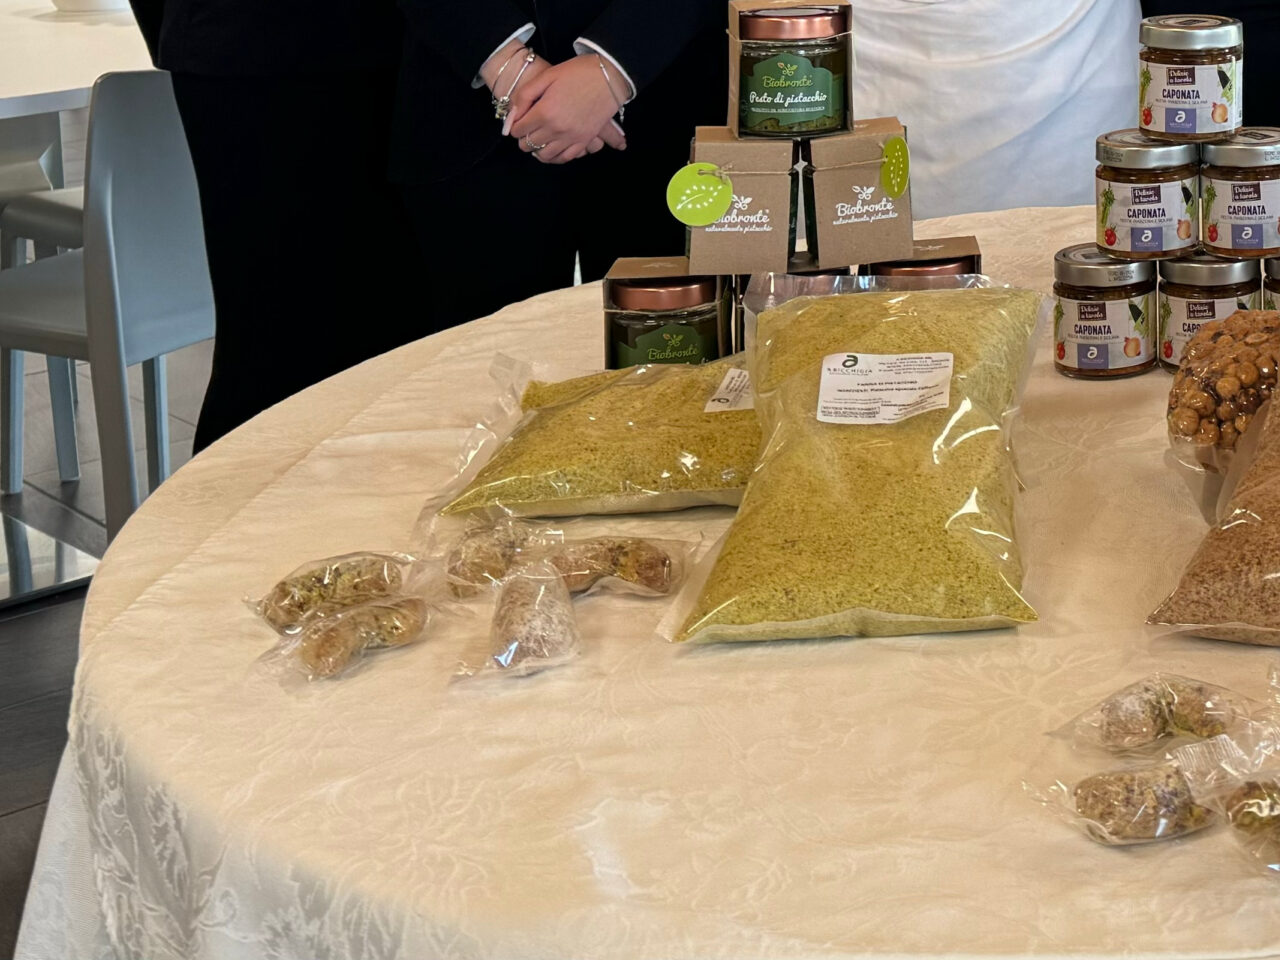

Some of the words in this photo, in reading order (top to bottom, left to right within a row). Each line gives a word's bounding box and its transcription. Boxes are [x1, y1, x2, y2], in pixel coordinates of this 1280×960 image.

[749, 91, 773, 103] Pesto
[774, 92, 784, 103] di
[784, 91, 827, 107] pistacchio
[1162, 88, 1201, 100] CAPONATA
[1127, 208, 1166, 219] CAPONATA
[1227, 205, 1266, 216] CAPONATA
[1073, 324, 1112, 336] CAPONATA
